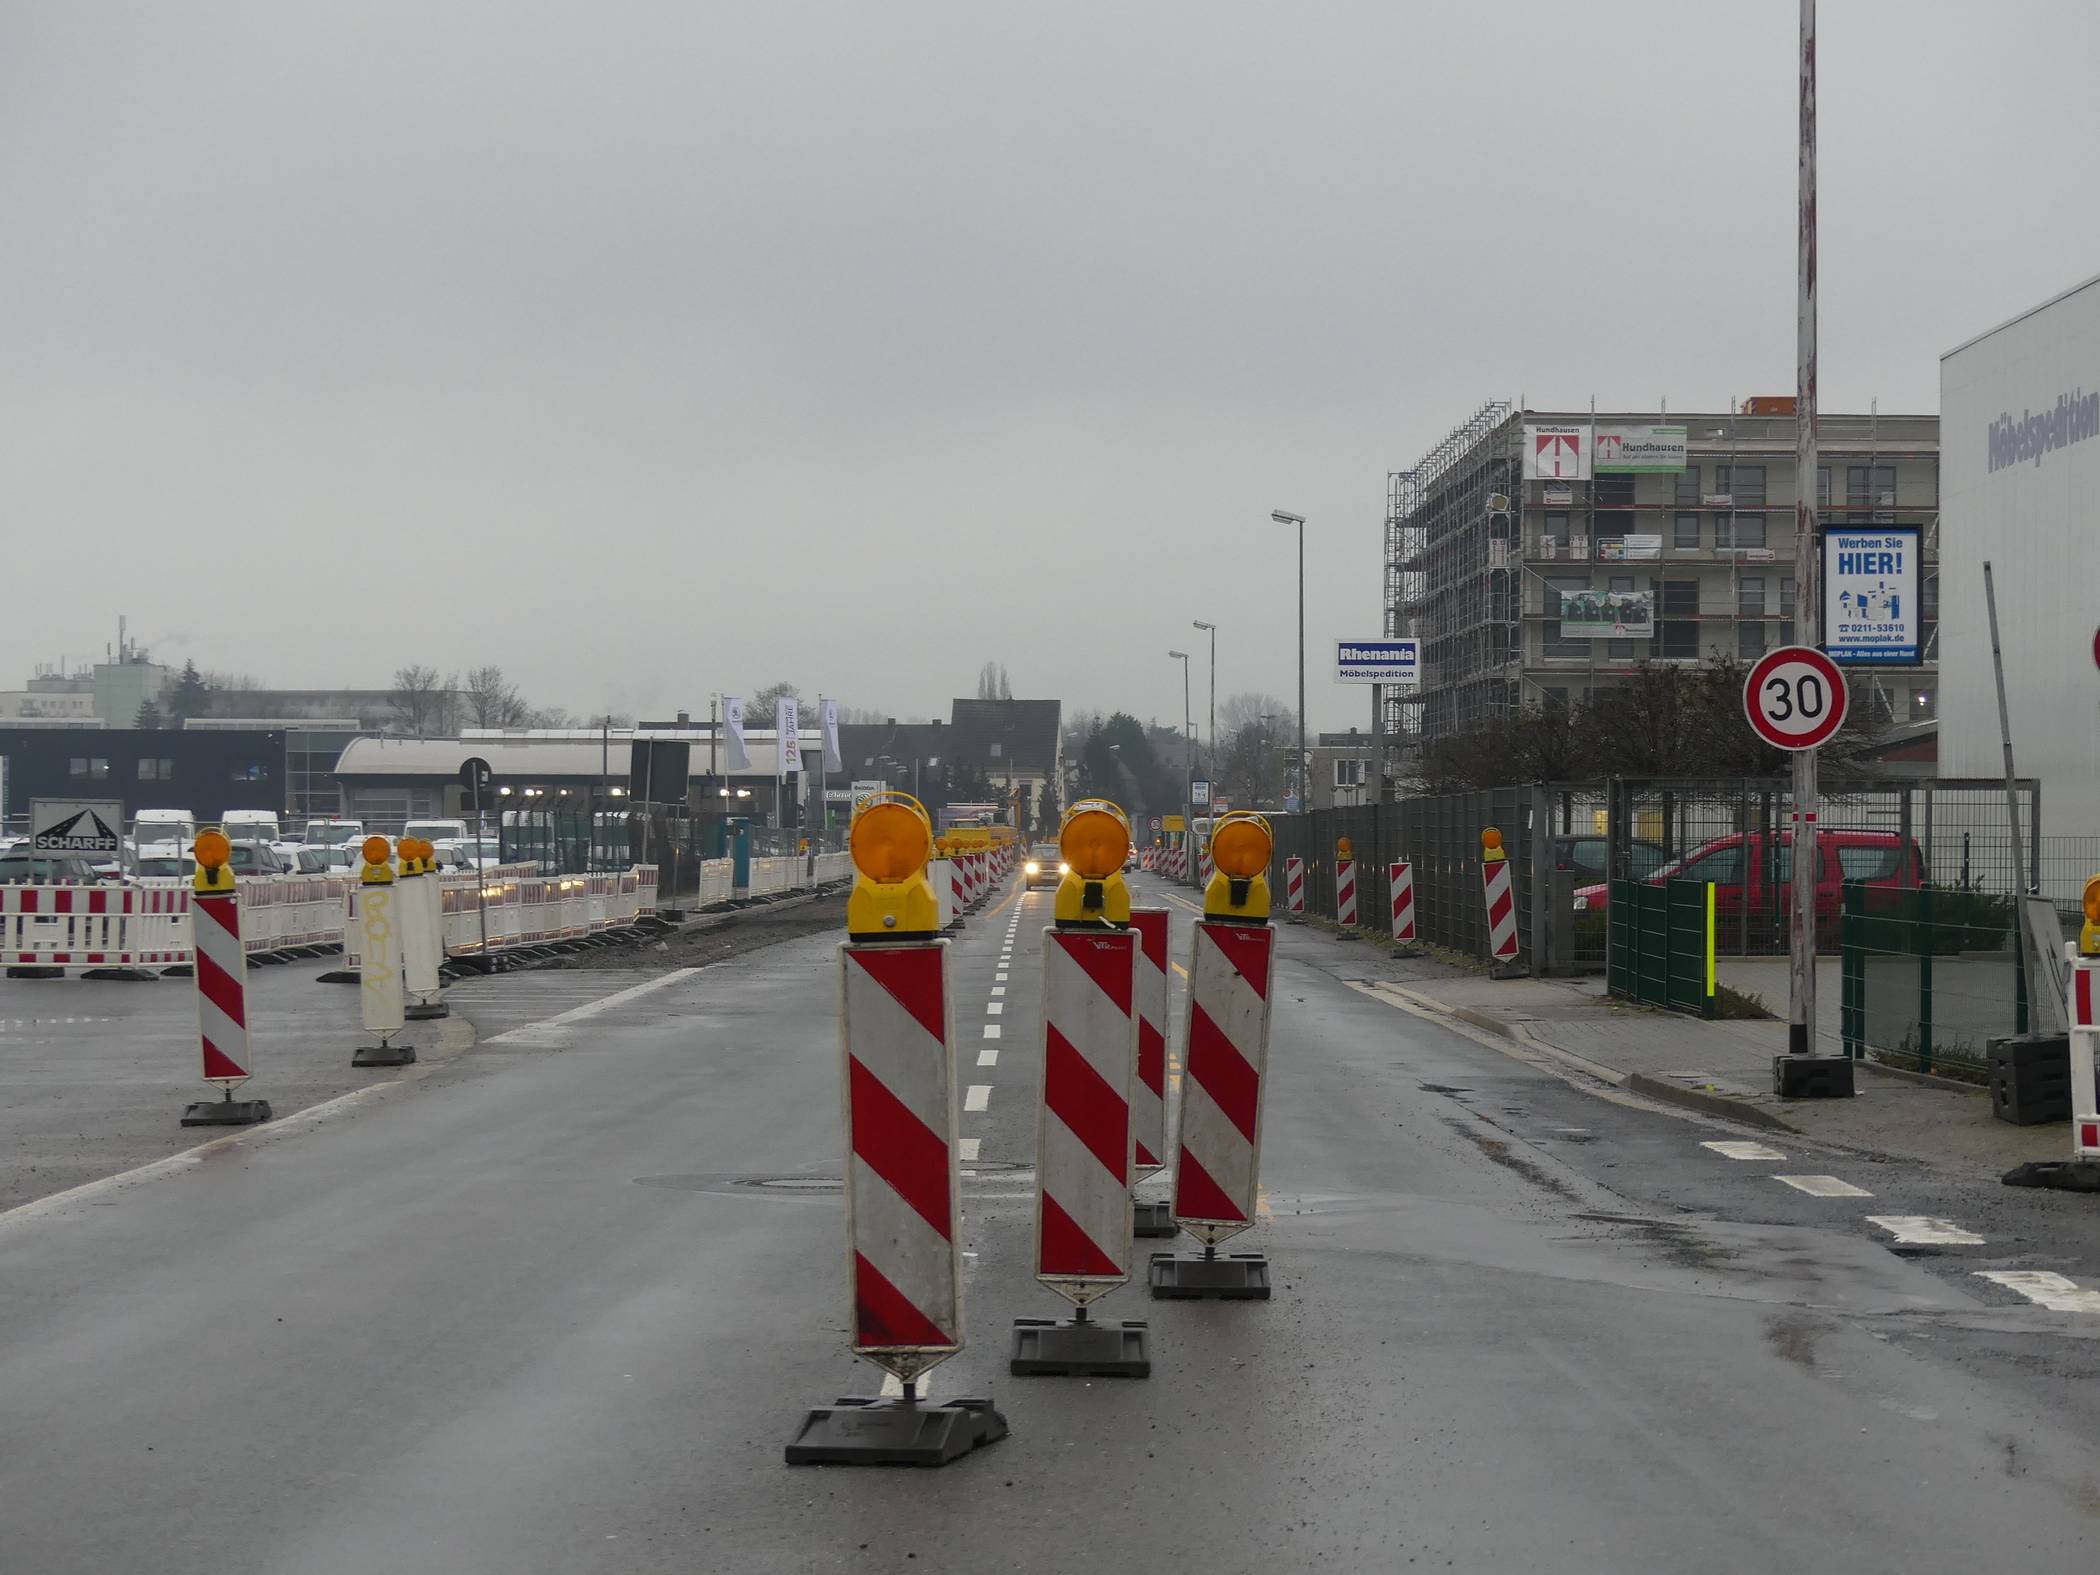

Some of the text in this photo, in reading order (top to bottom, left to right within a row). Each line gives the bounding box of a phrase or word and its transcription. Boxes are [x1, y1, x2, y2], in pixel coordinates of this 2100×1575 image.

[1536, 426, 1580, 434] Hundhausen
[1622, 442, 1684, 453] Hundhausen
[1838, 537, 1903, 549] Werben Sie
[1838, 552, 1903, 575] HIER!
[1838, 634, 1905, 644] www.moplak.de
[1339, 648, 1414, 661] Rhenania
[1339, 669, 1414, 680] Möbelspedition
[1765, 673, 1824, 722] 30
[785, 740, 797, 764] 125
[37, 836, 116, 850] SCHARFF
